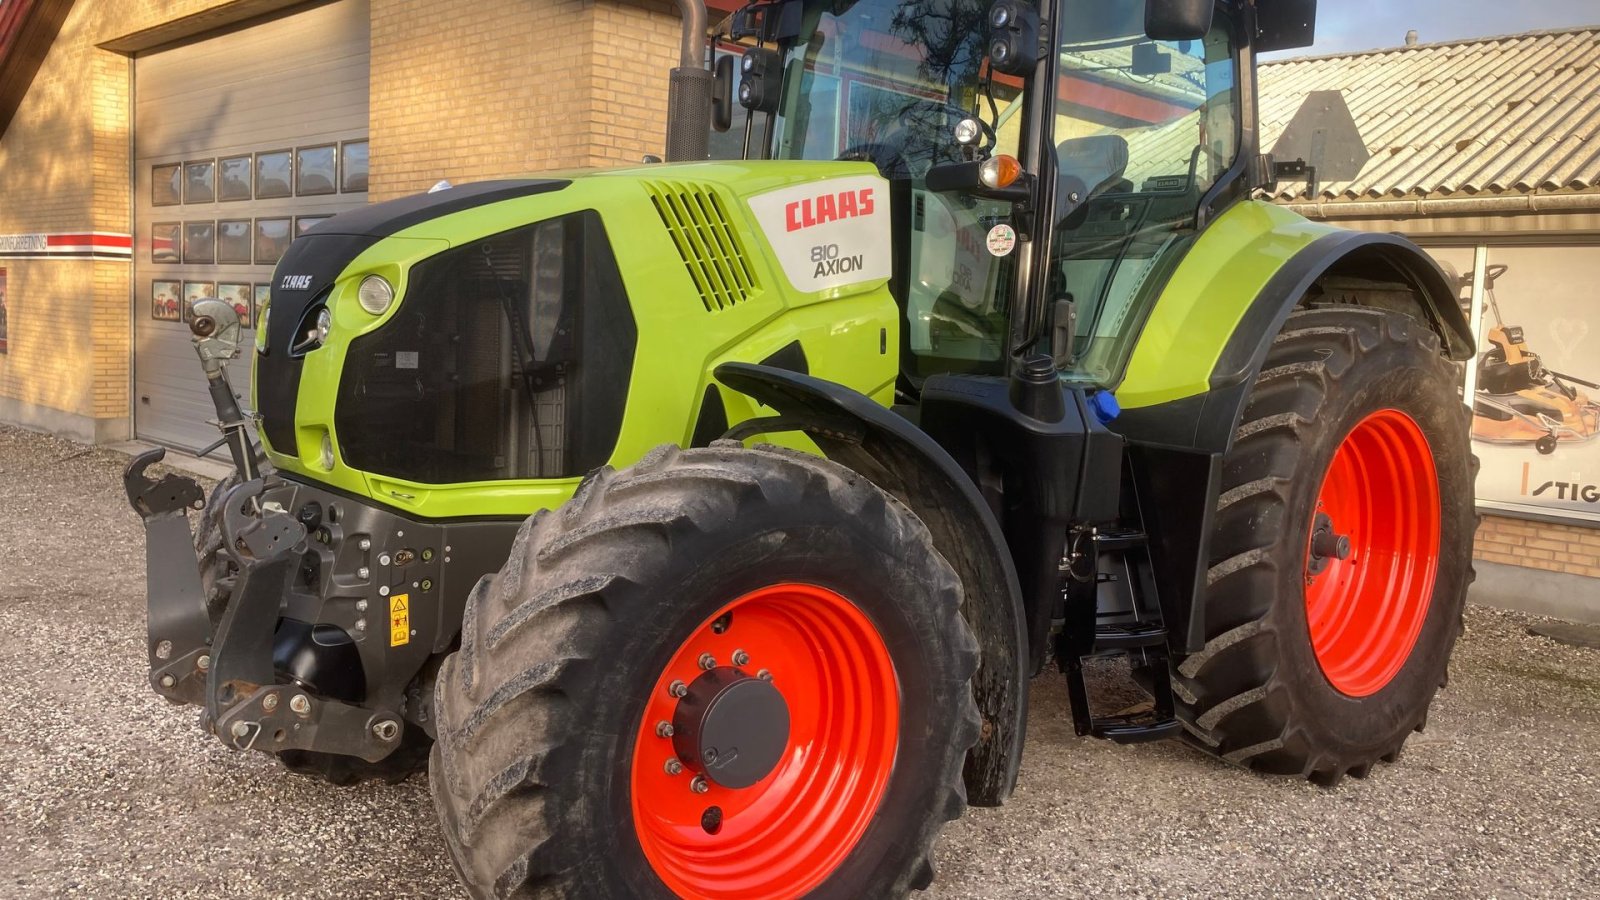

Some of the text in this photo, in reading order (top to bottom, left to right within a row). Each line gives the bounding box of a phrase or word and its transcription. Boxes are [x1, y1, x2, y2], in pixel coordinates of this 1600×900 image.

[785, 188, 874, 232] CLAAS
[810, 243, 839, 262] 810
[813, 254, 863, 279] AXION
[281, 275, 313, 289] CLAAS
